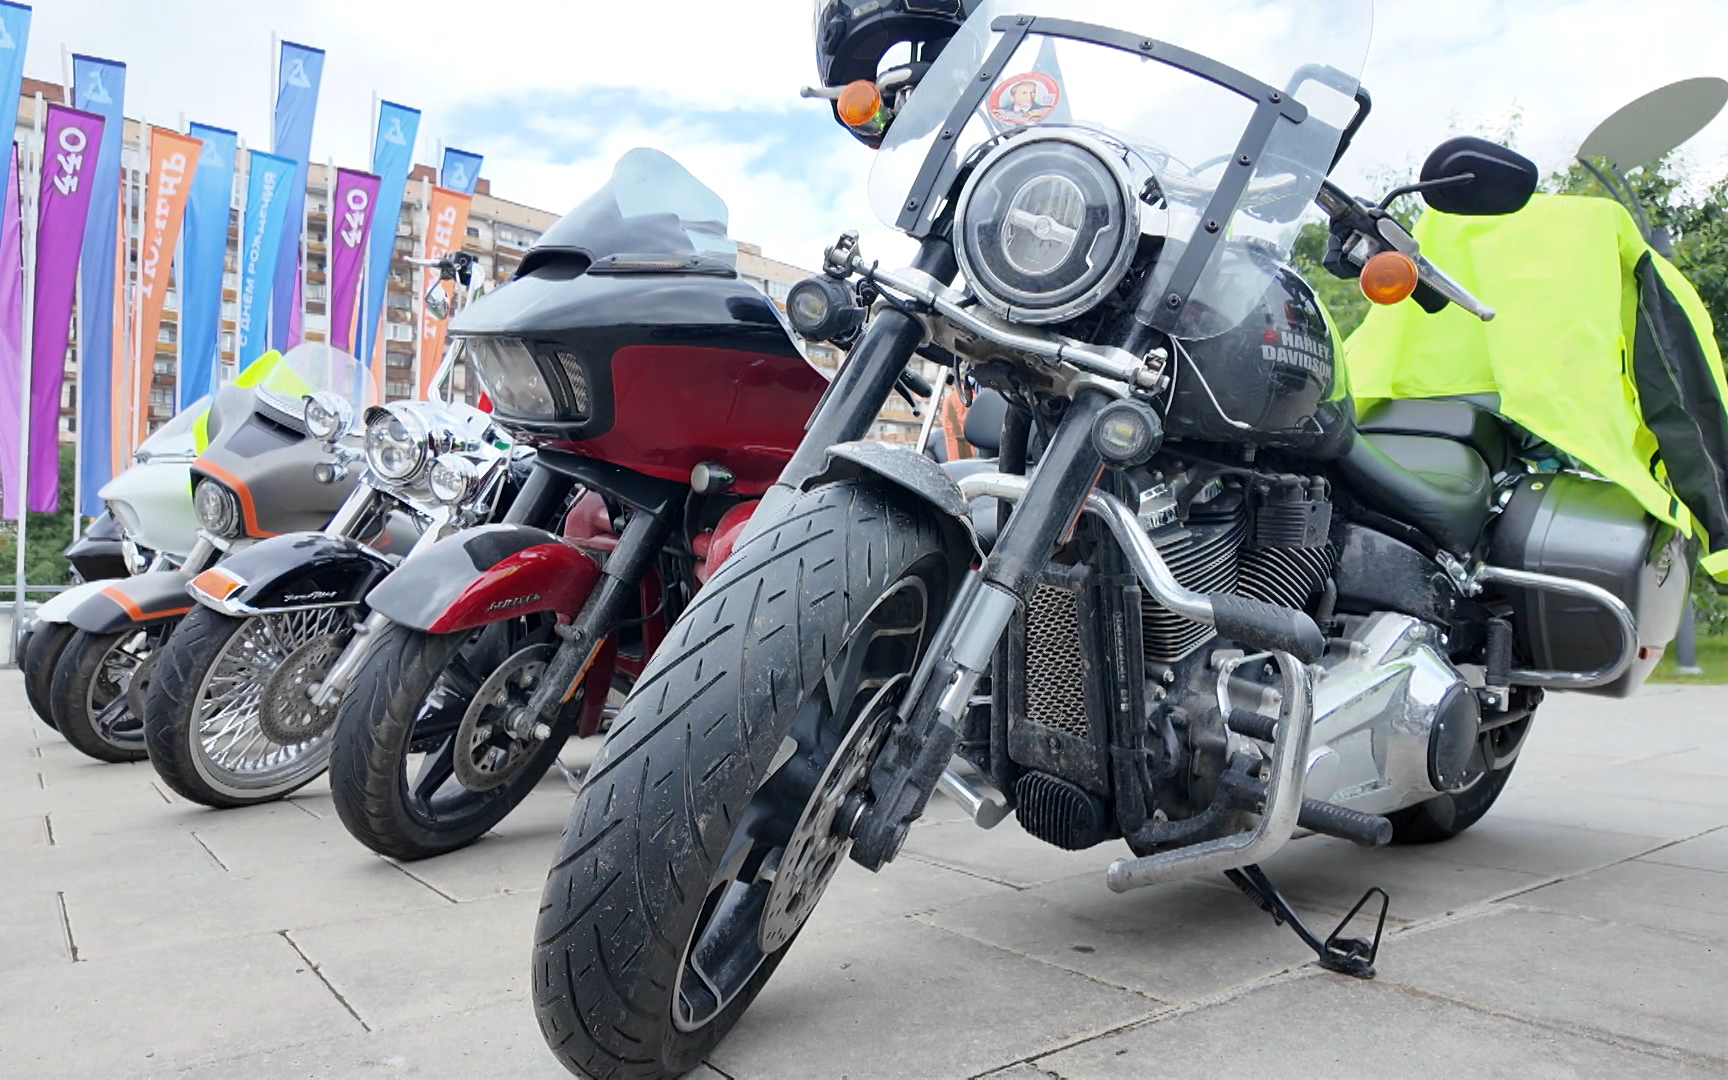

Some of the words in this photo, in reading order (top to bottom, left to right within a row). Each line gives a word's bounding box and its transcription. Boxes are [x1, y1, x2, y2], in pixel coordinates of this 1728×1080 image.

[53, 127, 87, 196] 440
[142, 154, 187, 298] ЮЕНЬ
[341, 189, 368, 248] 440
[424, 206, 457, 340] ТМЕНЬ
[1261, 344, 1332, 380] DAVIDSON
